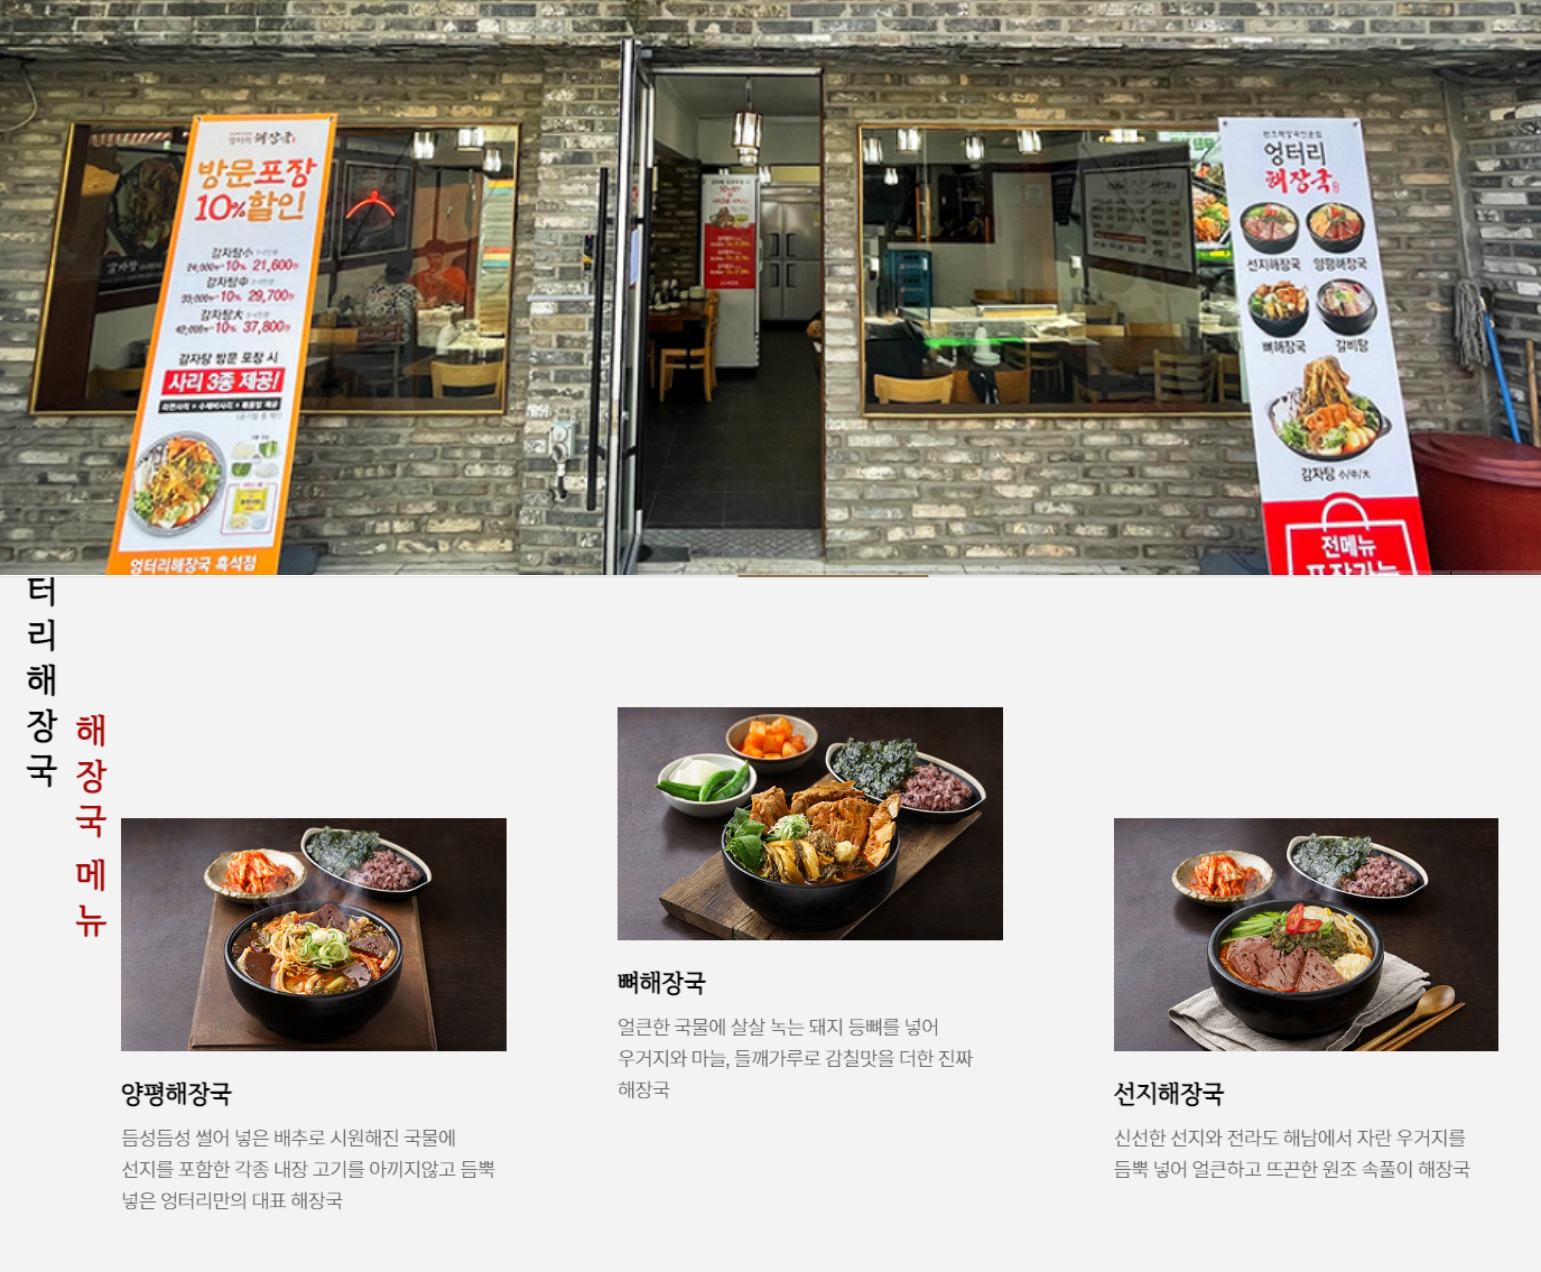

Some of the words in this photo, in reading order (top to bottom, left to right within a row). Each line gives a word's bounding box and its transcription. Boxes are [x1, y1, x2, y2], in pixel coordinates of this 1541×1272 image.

[1264, 141, 1326, 166] 엉터리
[198, 157, 318, 190] 방문포장
[1265, 168, 1332, 194] 해장국
[195, 190, 306, 222] 10%할인
[1247, 257, 1302, 272] 선지해장국
[1313, 257, 1368, 272] 양평해장국
[266, 352, 278, 363] 시
[168, 372, 204, 392] 사리
[206, 371, 235, 391] 3종
[239, 370, 281, 391] 제공!
[1301, 466, 1335, 482] 감자탕
[1321, 534, 1377, 559] 전메뉴
[130, 557, 211, 575] 엉터리해장국
[215, 554, 258, 572] 흑석점
